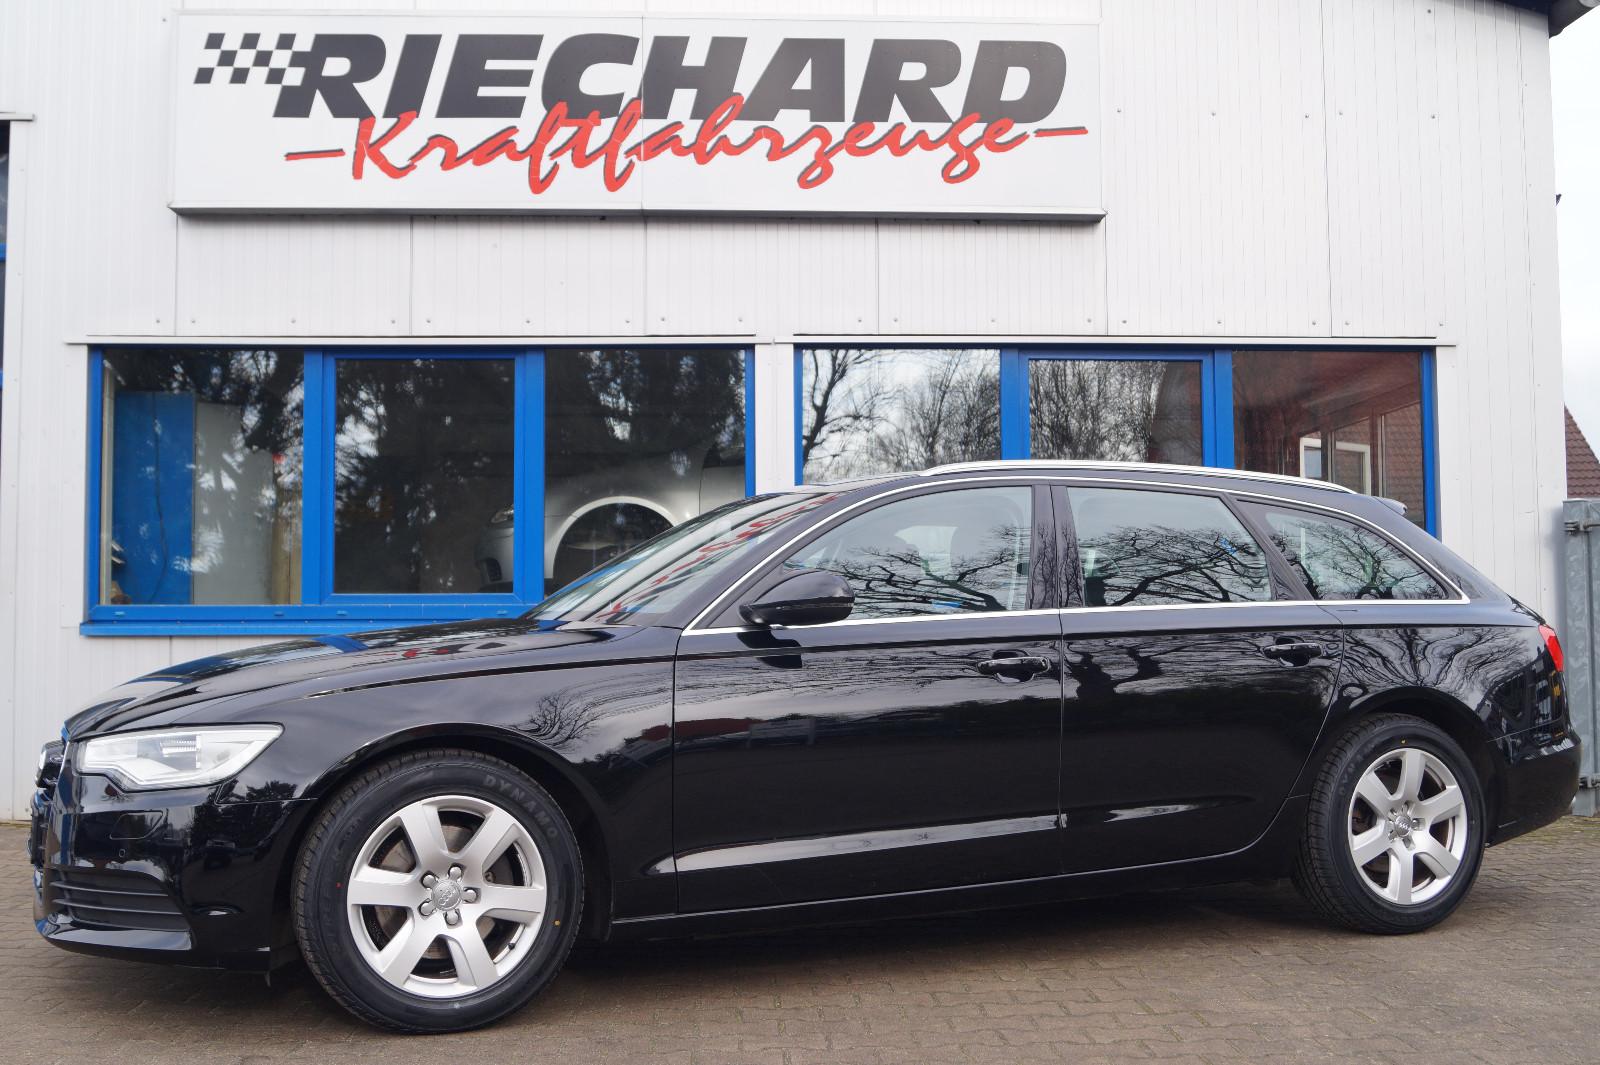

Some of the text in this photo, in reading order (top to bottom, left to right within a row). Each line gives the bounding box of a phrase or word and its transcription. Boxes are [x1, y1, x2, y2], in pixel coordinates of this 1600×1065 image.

[272, 33, 1067, 124] RIECHARD
[352, 93, 1031, 194] Kraftfahrzeuge
[482, 774, 558, 838] DYNAMO
